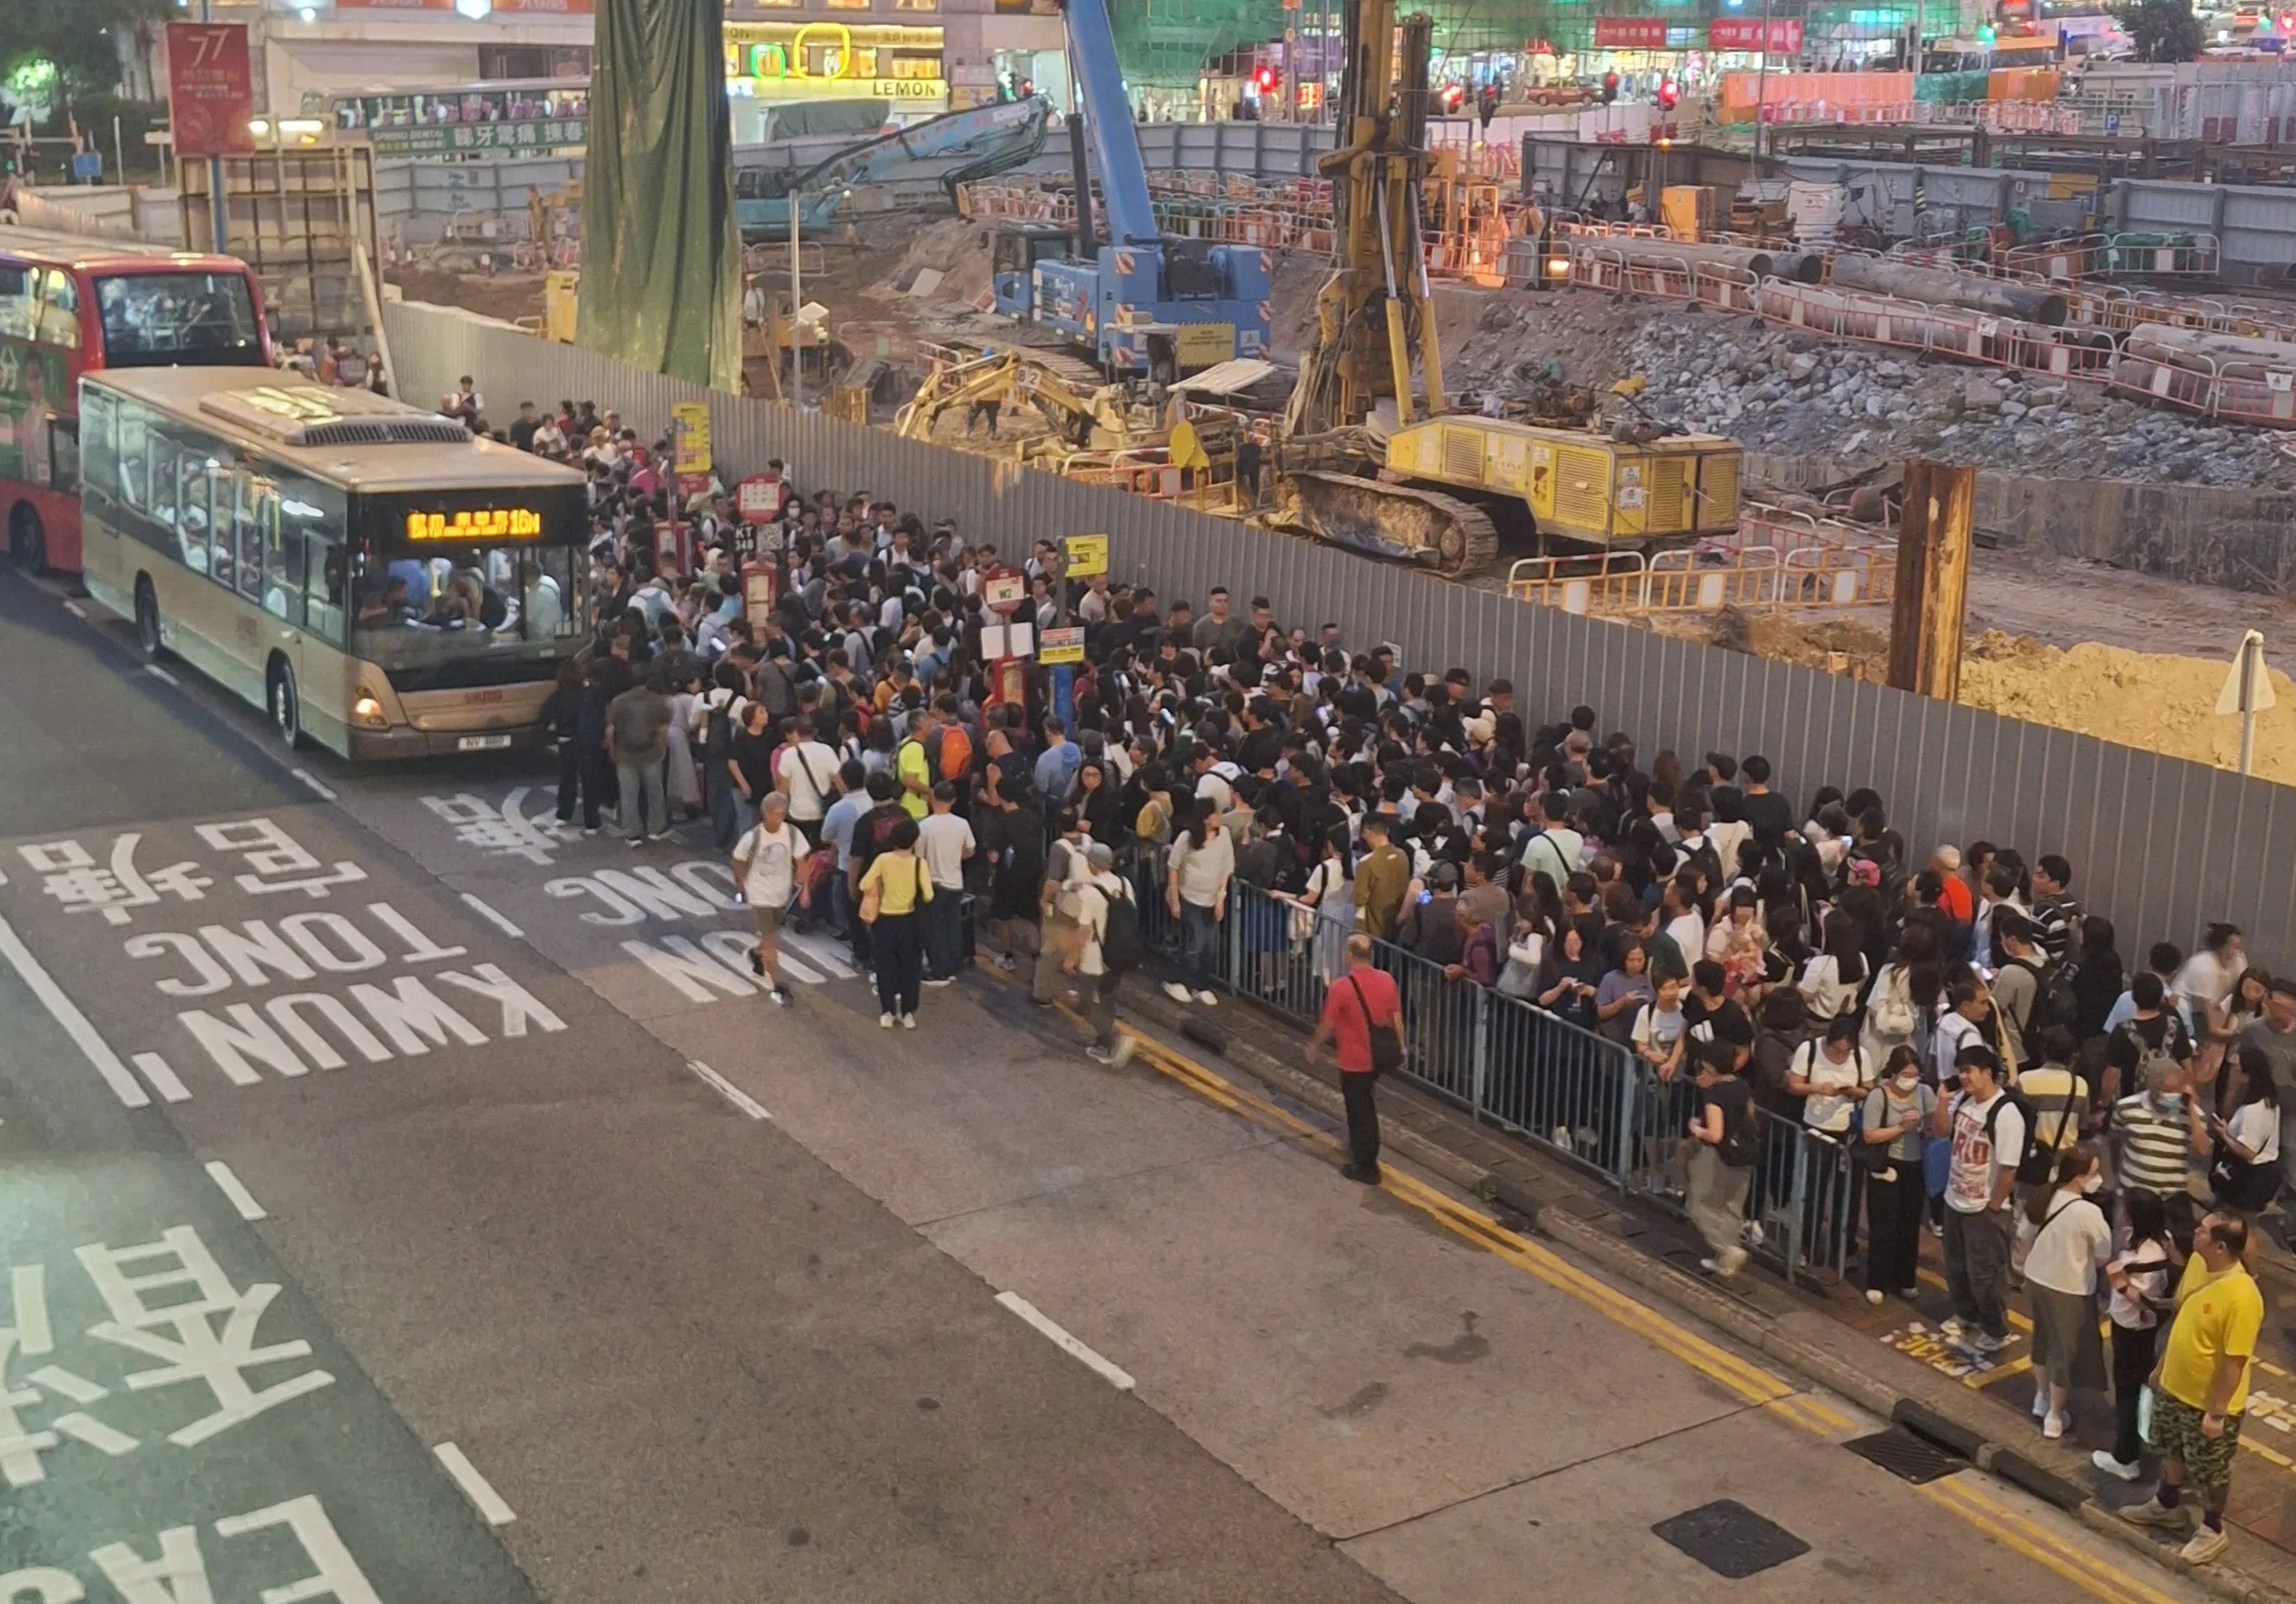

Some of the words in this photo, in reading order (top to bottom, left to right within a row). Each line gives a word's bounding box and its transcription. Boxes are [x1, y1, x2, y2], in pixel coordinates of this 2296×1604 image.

[188, 28, 230, 67] 77
[873, 82, 936, 96] LEMON
[2107, 114, 2118, 129] P
[1018, 369, 1038, 384] 82
[735, 526, 753, 538] KT
[999, 589, 1012, 599] W2
[544, 860, 750, 926] ONG
[124, 902, 468, 996] TONG
[177, 963, 569, 1086] KWUN
